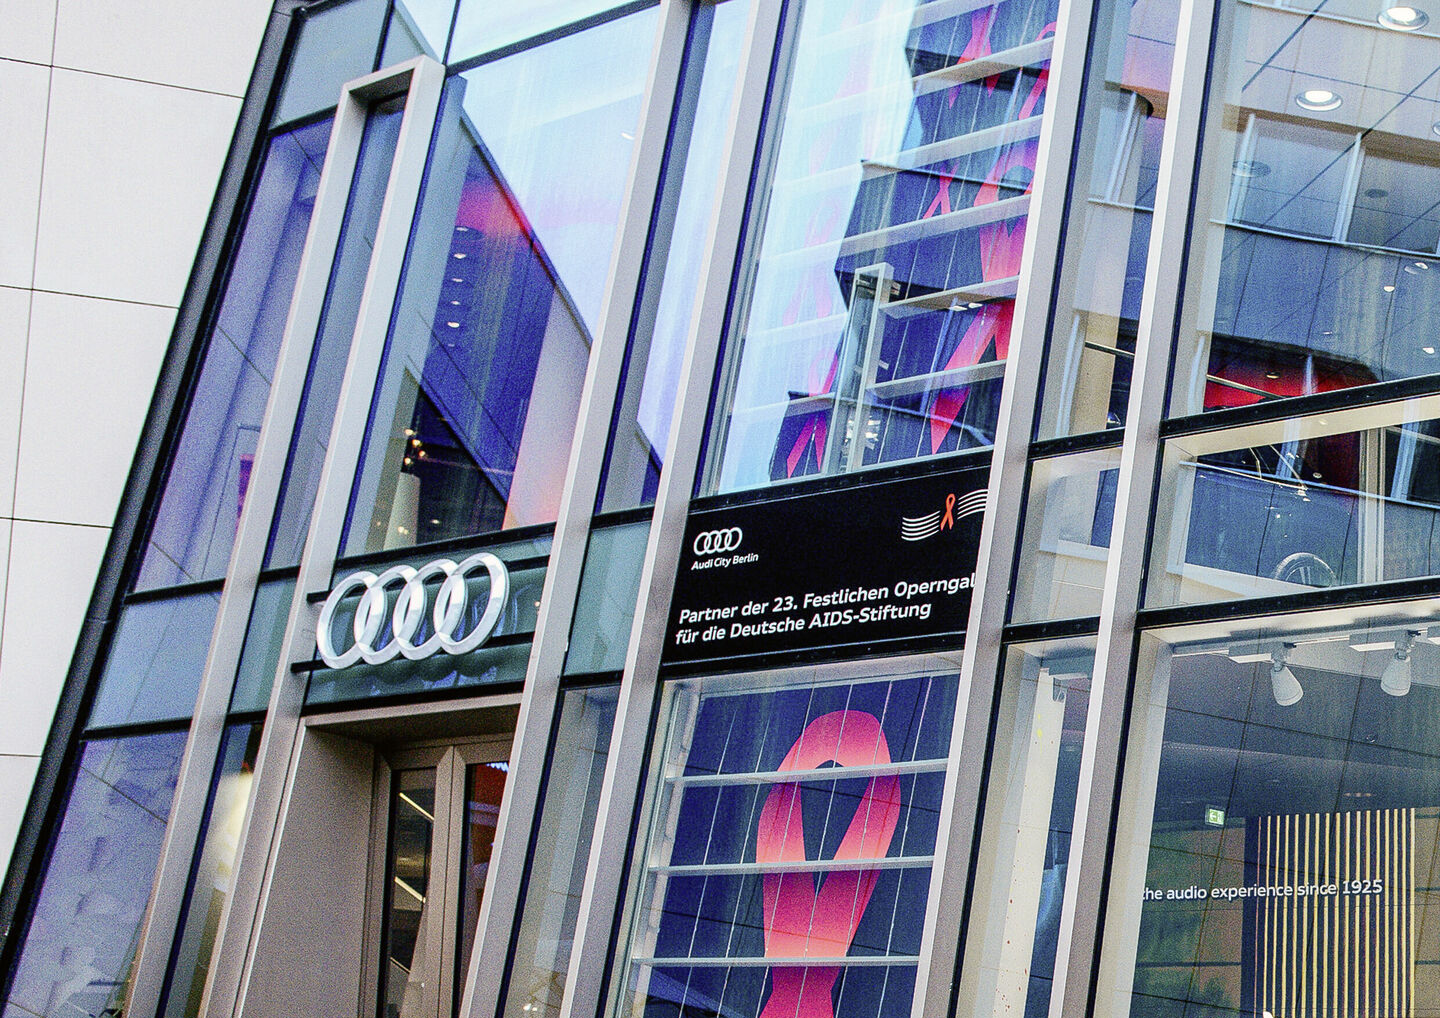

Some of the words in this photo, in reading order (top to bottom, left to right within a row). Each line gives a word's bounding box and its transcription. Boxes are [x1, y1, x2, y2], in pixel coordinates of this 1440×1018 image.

[690, 558, 714, 571] Audi
[713, 557, 732, 568] City
[732, 552, 759, 565] Berlin
[679, 606, 739, 624] Partner
[741, 600, 770, 616] der
[772, 595, 798, 613] 23.
[803, 586, 889, 608] Festlichen
[893, 572, 976, 600] Operngal
[675, 628, 700, 645] für
[701, 626, 726, 641] die
[729, 616, 806, 639] Deutsche
[807, 602, 932, 630] AIDS-Stiftung
[1166, 886, 1207, 901] audio
[1211, 883, 1293, 903] experience
[1297, 882, 1338, 896] since
[1341, 879, 1384, 895] 1925
